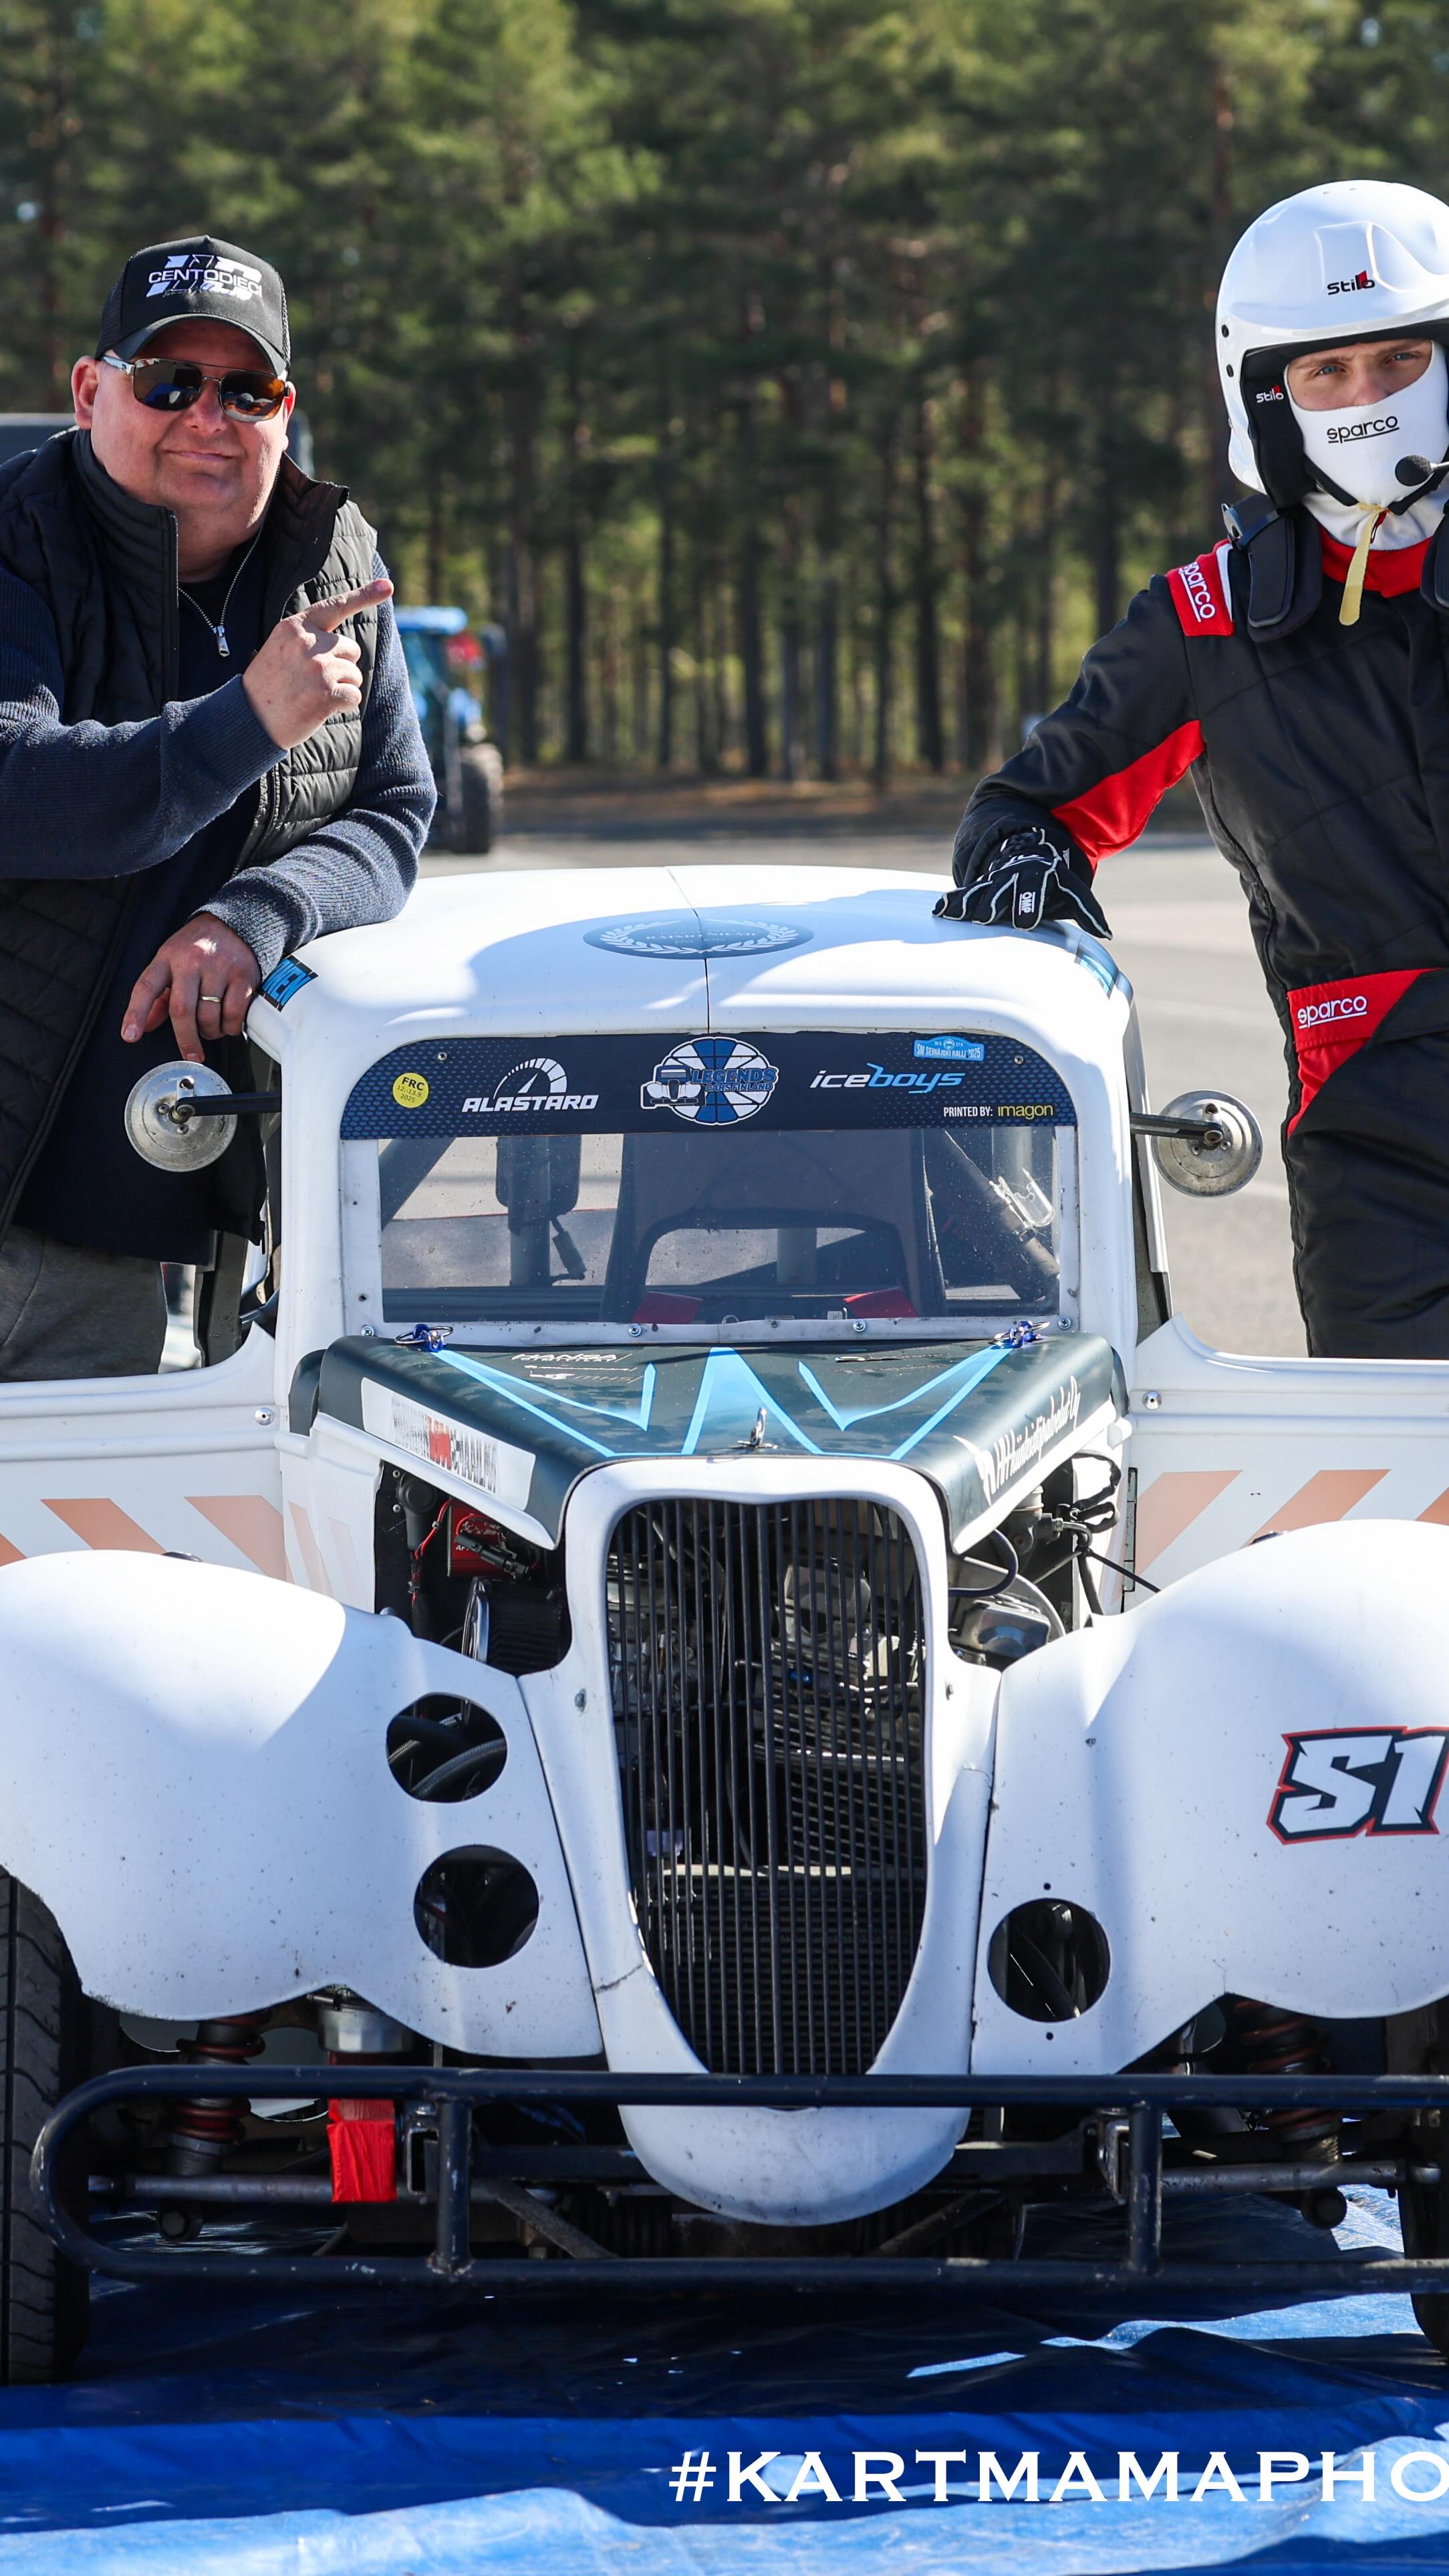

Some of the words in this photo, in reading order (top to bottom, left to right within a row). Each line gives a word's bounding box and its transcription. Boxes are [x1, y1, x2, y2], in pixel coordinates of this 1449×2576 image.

[148, 269, 262, 298] CENTODIECI
[1327, 416, 1400, 444] sparco
[1021, 892, 1033, 913] OMP
[1297, 996, 1367, 1029] sparco
[402, 1077, 425, 1091] FRC
[692, 1069, 778, 1083] LEGENDS
[809, 1063, 966, 1093] iceboys
[706, 1083, 733, 1091] CARS
[734, 1083, 773, 1091] FINLAND
[400, 1093, 415, 1103] 2025
[461, 1095, 599, 1112] ALASTARO
[944, 1106, 978, 1118] PRINTED
[980, 1106, 993, 1117] BY:
